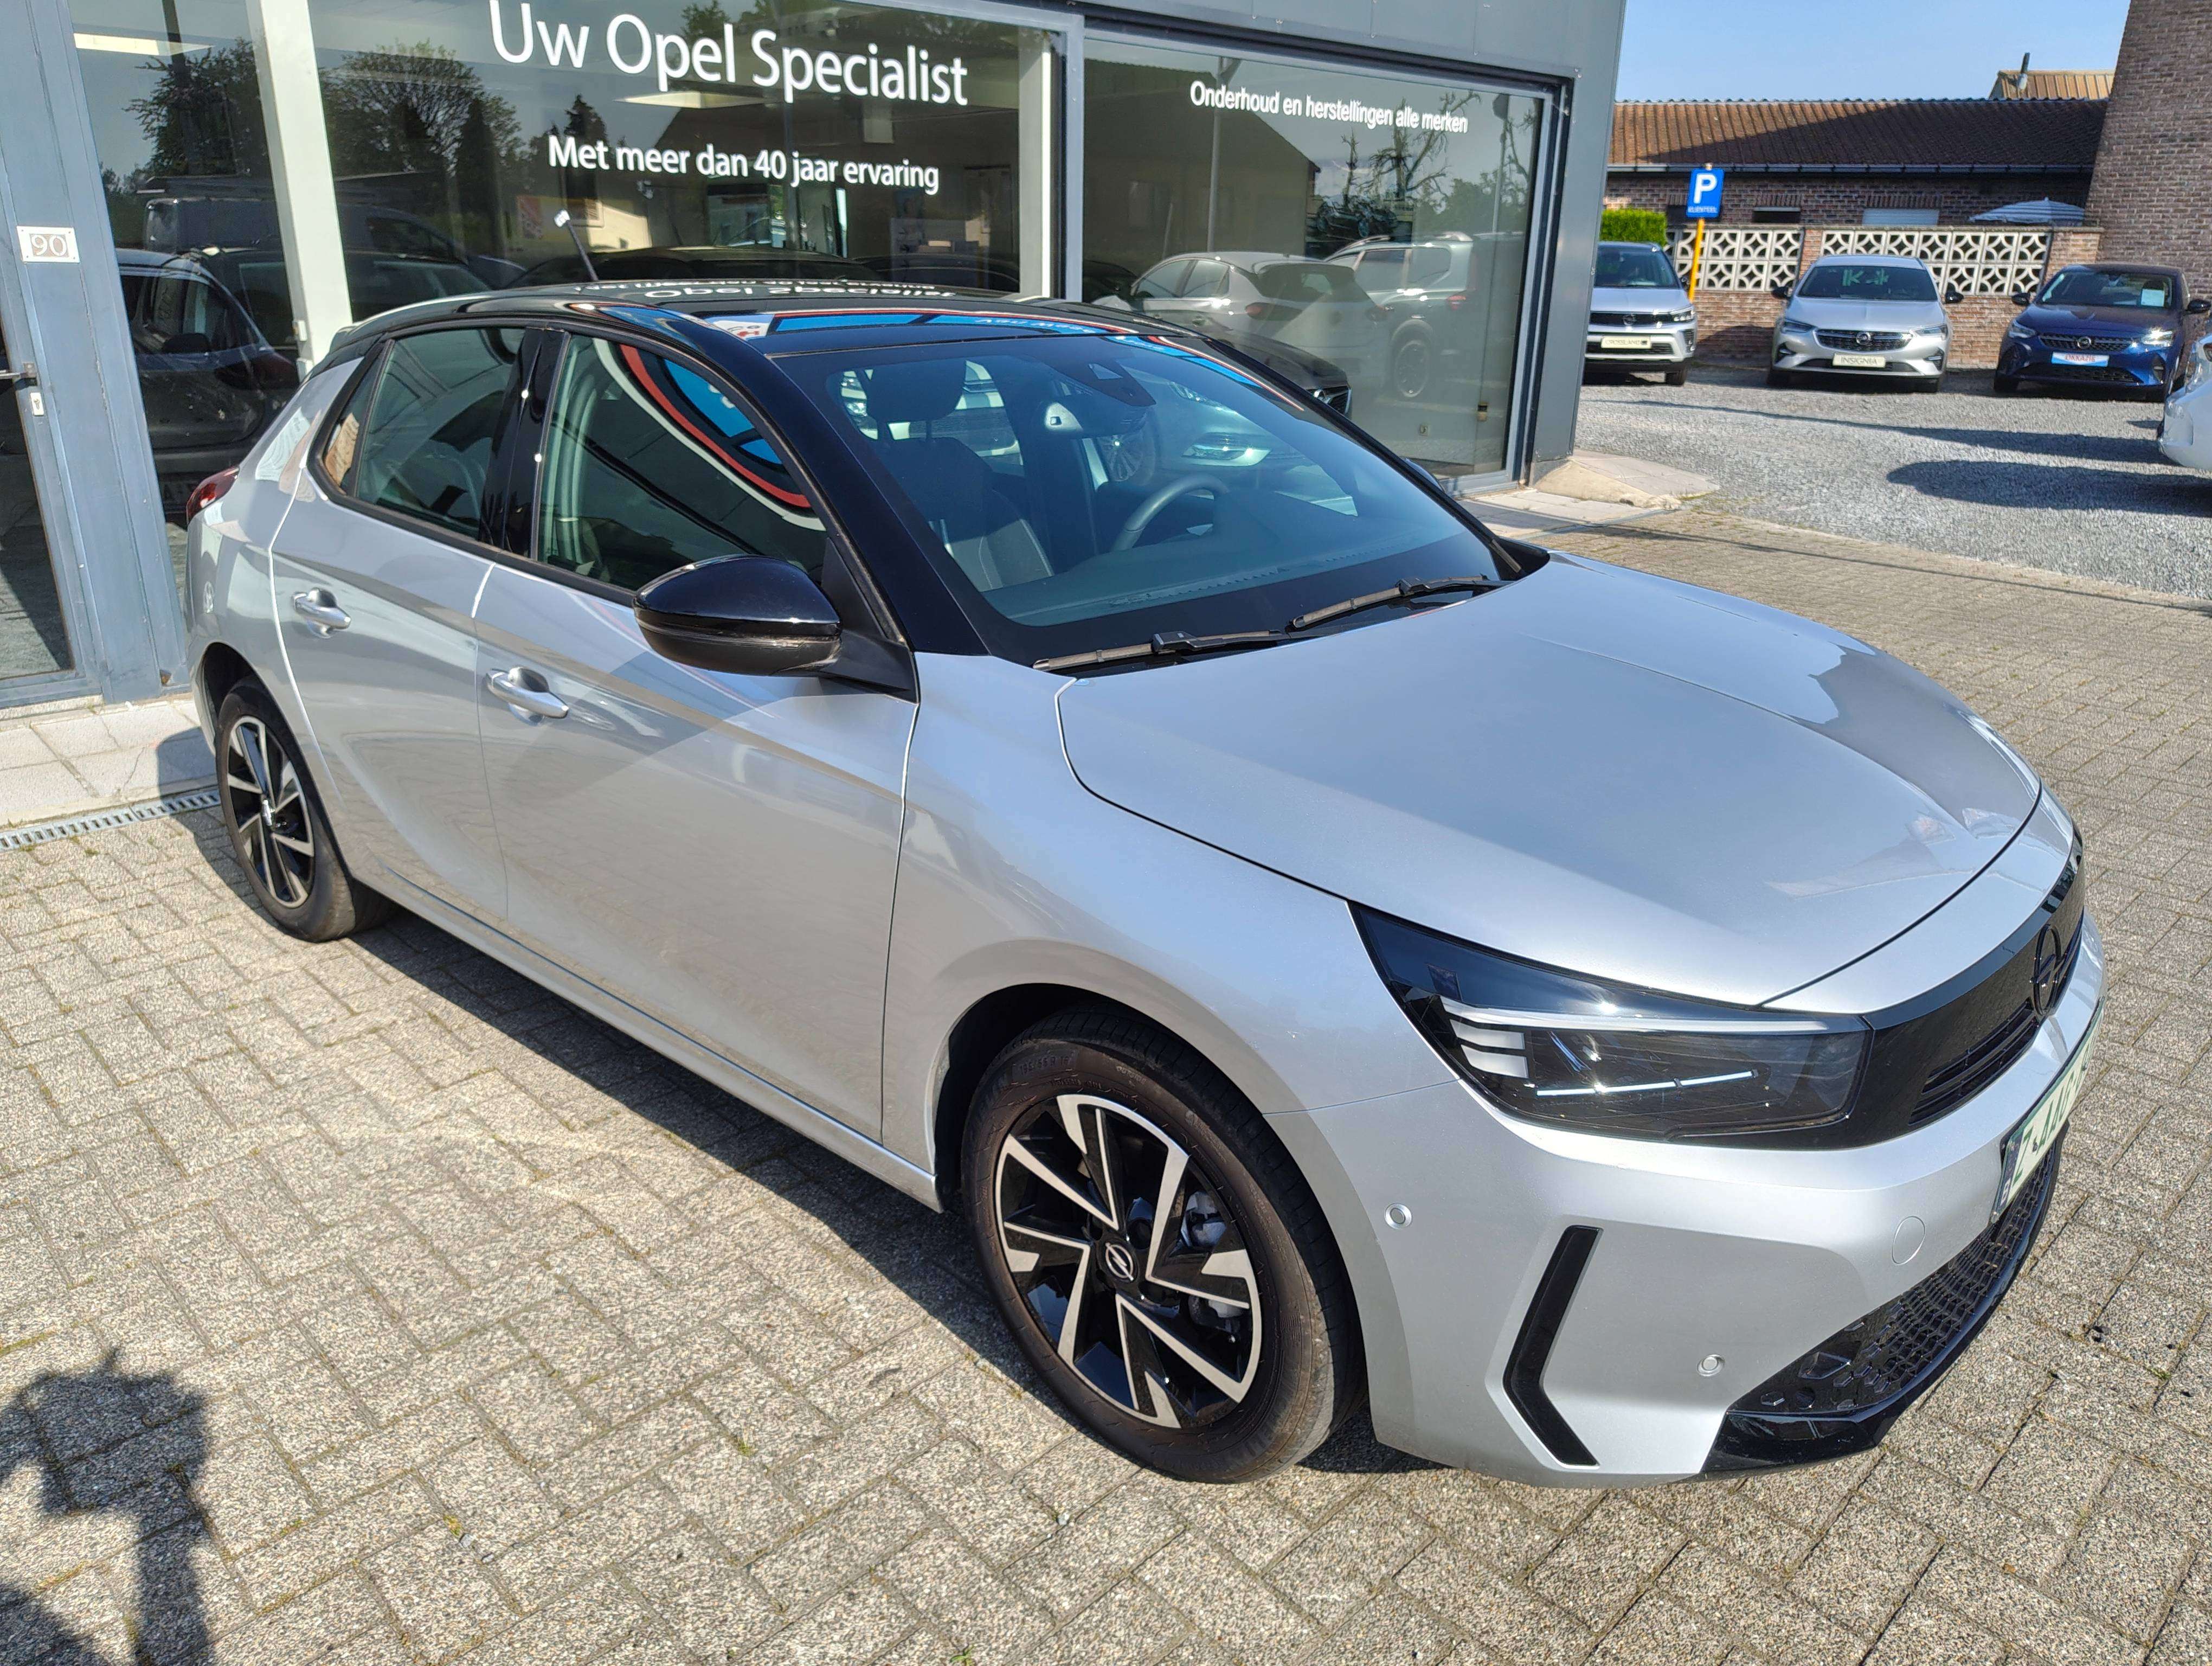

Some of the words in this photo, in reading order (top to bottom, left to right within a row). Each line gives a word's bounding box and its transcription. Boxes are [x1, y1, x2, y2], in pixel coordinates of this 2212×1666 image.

[490, 0, 589, 68] Uw
[607, 14, 736, 92] Opel
[751, 30, 968, 105] Specialist
[1190, 81, 1280, 114] Onderhoud
[1283, 98, 1302, 116] en
[1306, 95, 1393, 130] herstellingen
[1396, 106, 1419, 129] alle
[1422, 112, 1468, 133] merken
[549, 135, 609, 170] Met
[616, 147, 690, 174] meer
[696, 144, 748, 177] dan
[754, 150, 787, 179] 40
[790, 152, 839, 188] jaar
[843, 158, 939, 195] ervaring
[1693, 173, 1718, 204] P
[31, 233, 68, 257] 90
